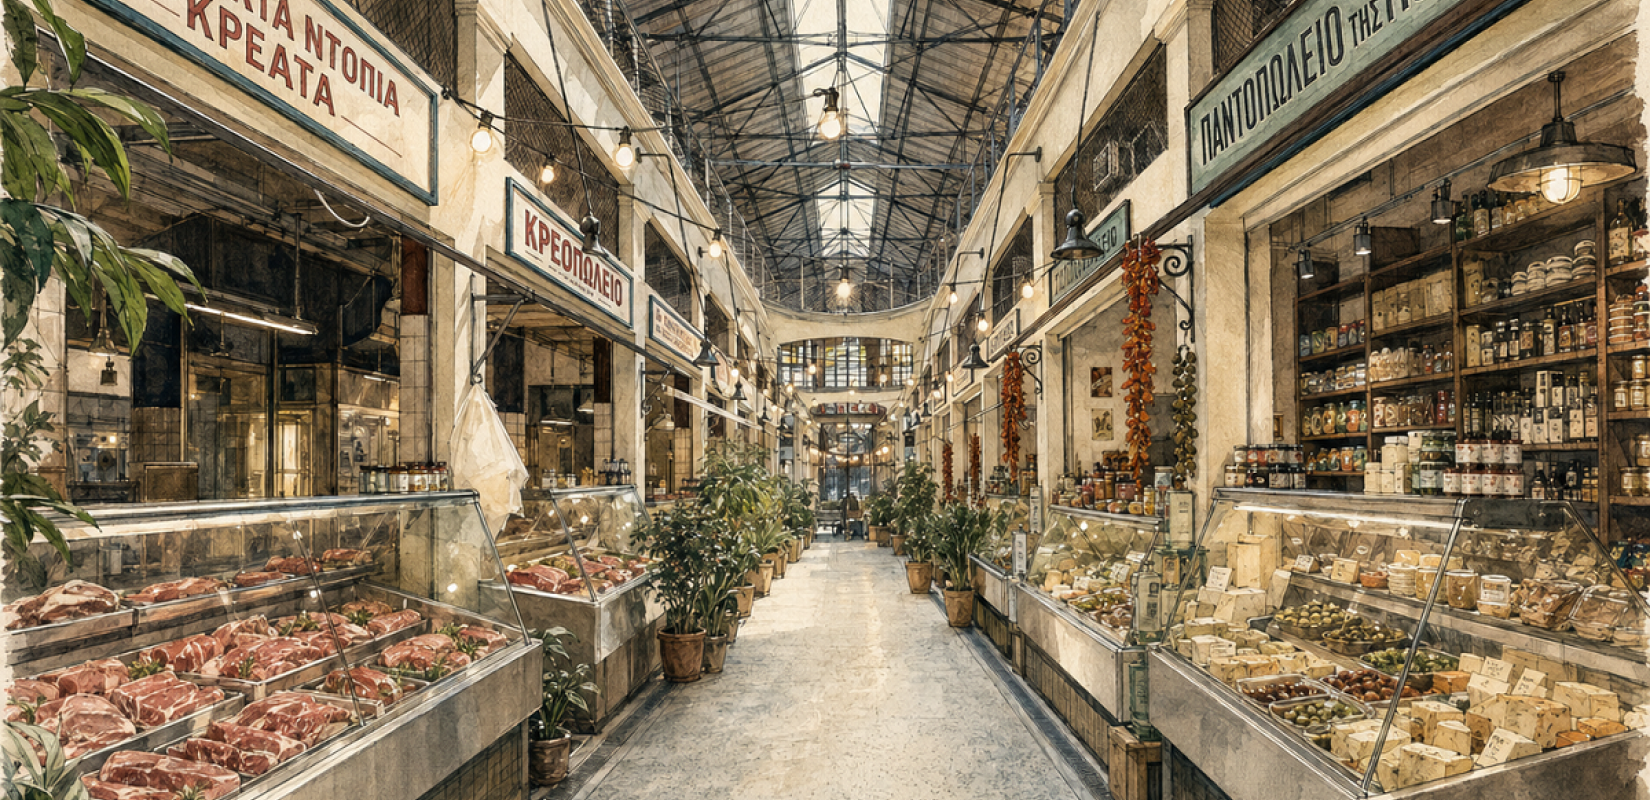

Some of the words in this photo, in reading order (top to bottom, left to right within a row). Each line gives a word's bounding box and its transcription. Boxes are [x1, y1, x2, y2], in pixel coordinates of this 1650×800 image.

[187, 0, 335, 117] ΚΡΕΑΤΑ
[305, 15, 400, 118] ΝΤΟΠΙΑ
[1201, 6, 1344, 166] ΠΑΝΤΟΠΩΛΕΙΟ
[1348, 0, 1383, 48] ΤΗΣ
[525, 209, 622, 307] ΚΡΕΟΠΩΛΕΙΟ
